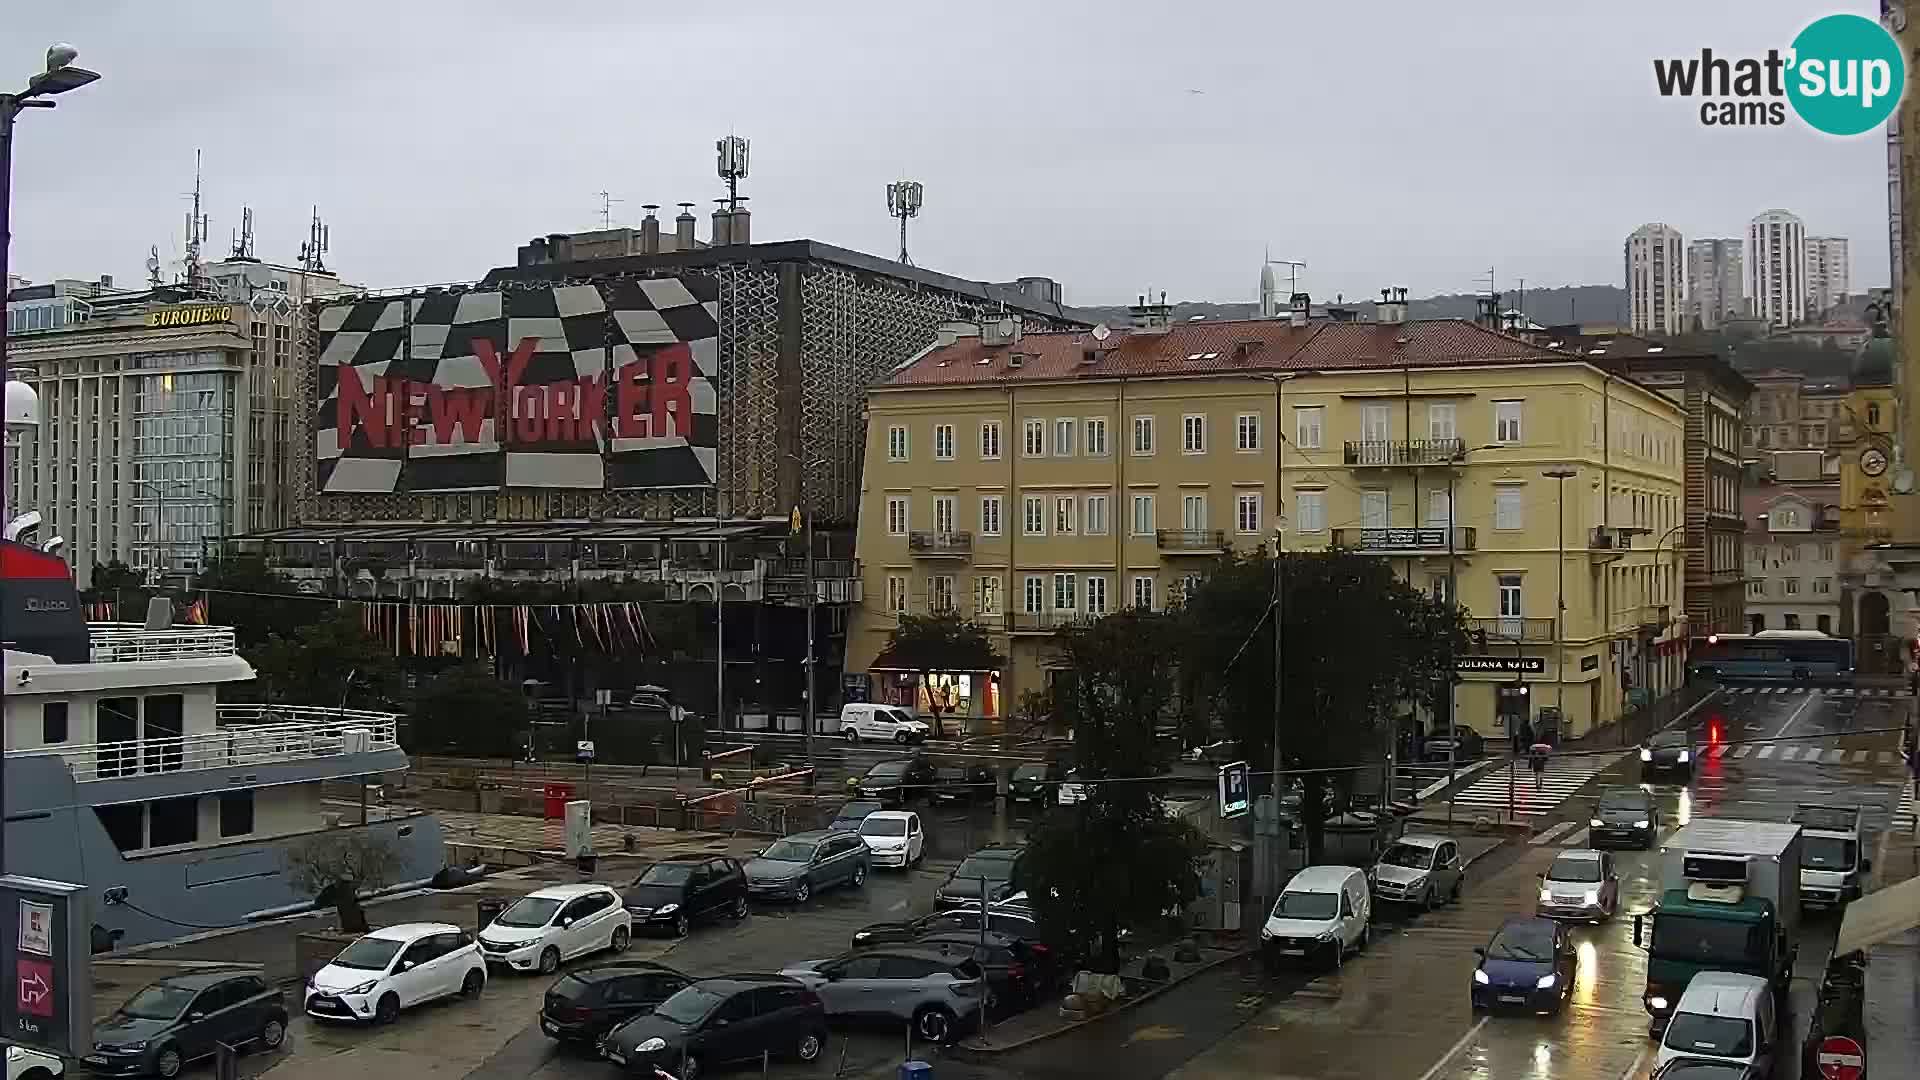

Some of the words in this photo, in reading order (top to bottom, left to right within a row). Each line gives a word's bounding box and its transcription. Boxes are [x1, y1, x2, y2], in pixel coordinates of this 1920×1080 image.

[337, 360, 500, 449] NEW
[471, 336, 693, 444] YORKER
[1457, 660, 1503, 669] JULIANA
